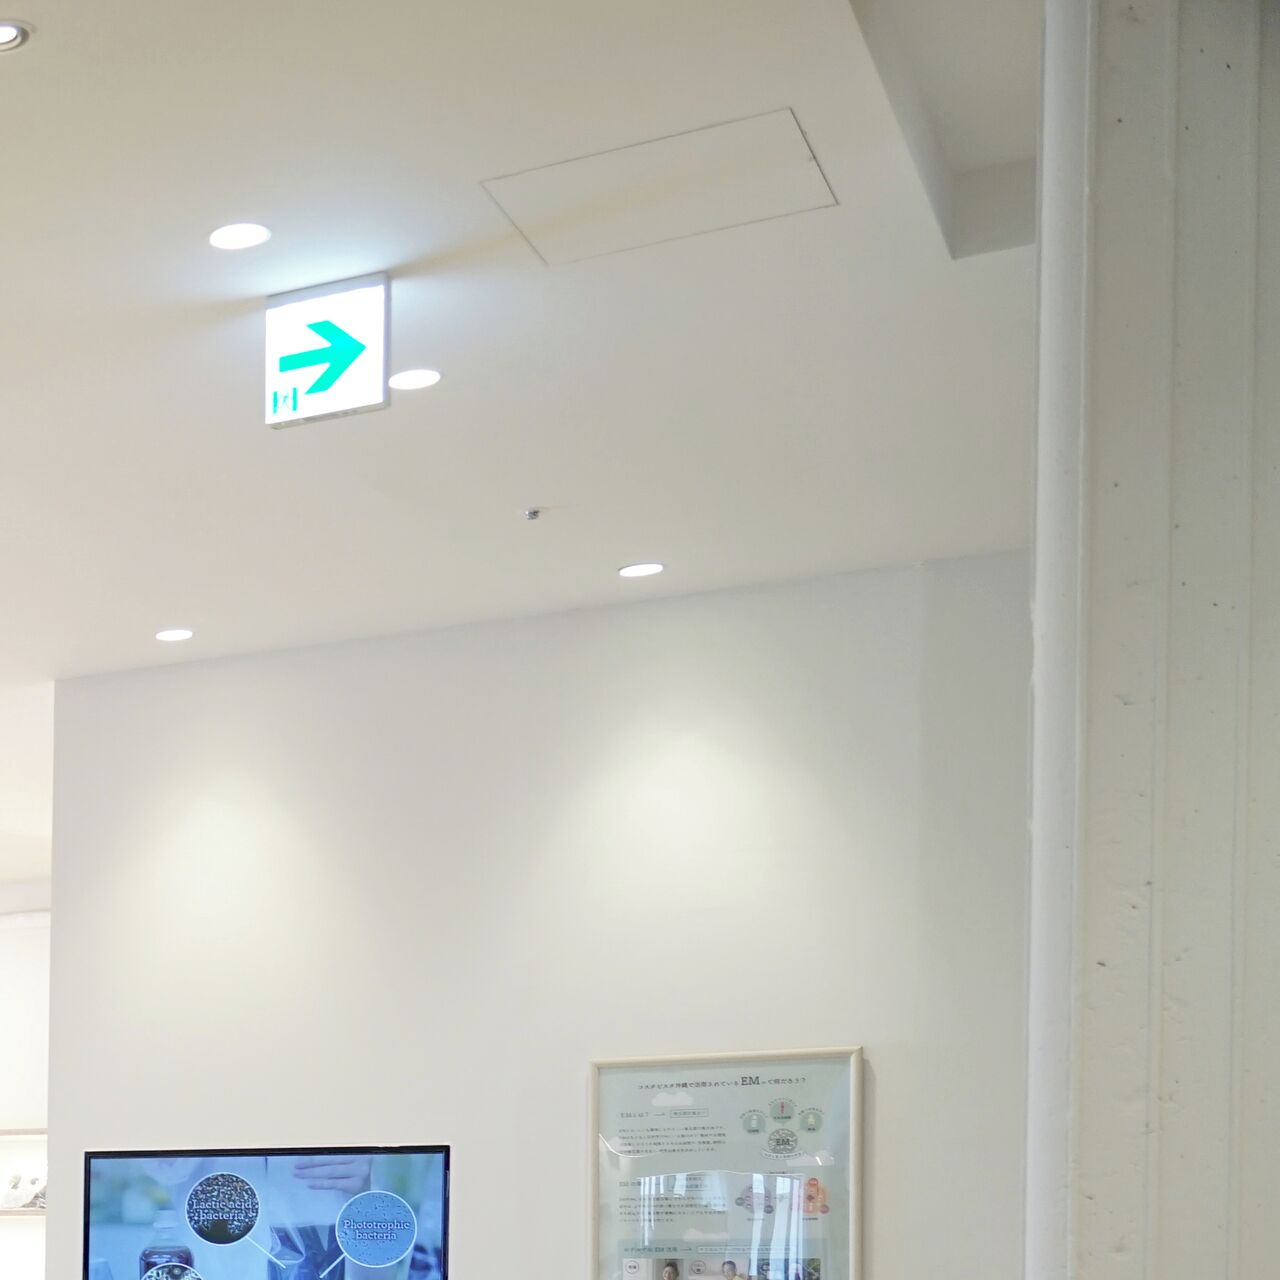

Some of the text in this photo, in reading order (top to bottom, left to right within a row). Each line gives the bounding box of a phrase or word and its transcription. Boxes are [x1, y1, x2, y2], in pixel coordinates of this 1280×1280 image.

[193, 1199, 252, 1209] Lactic acid
[200, 1209, 244, 1220] bacteria
[343, 1219, 410, 1231] Phototrophic
[356, 1230, 397, 1240] bacteria
